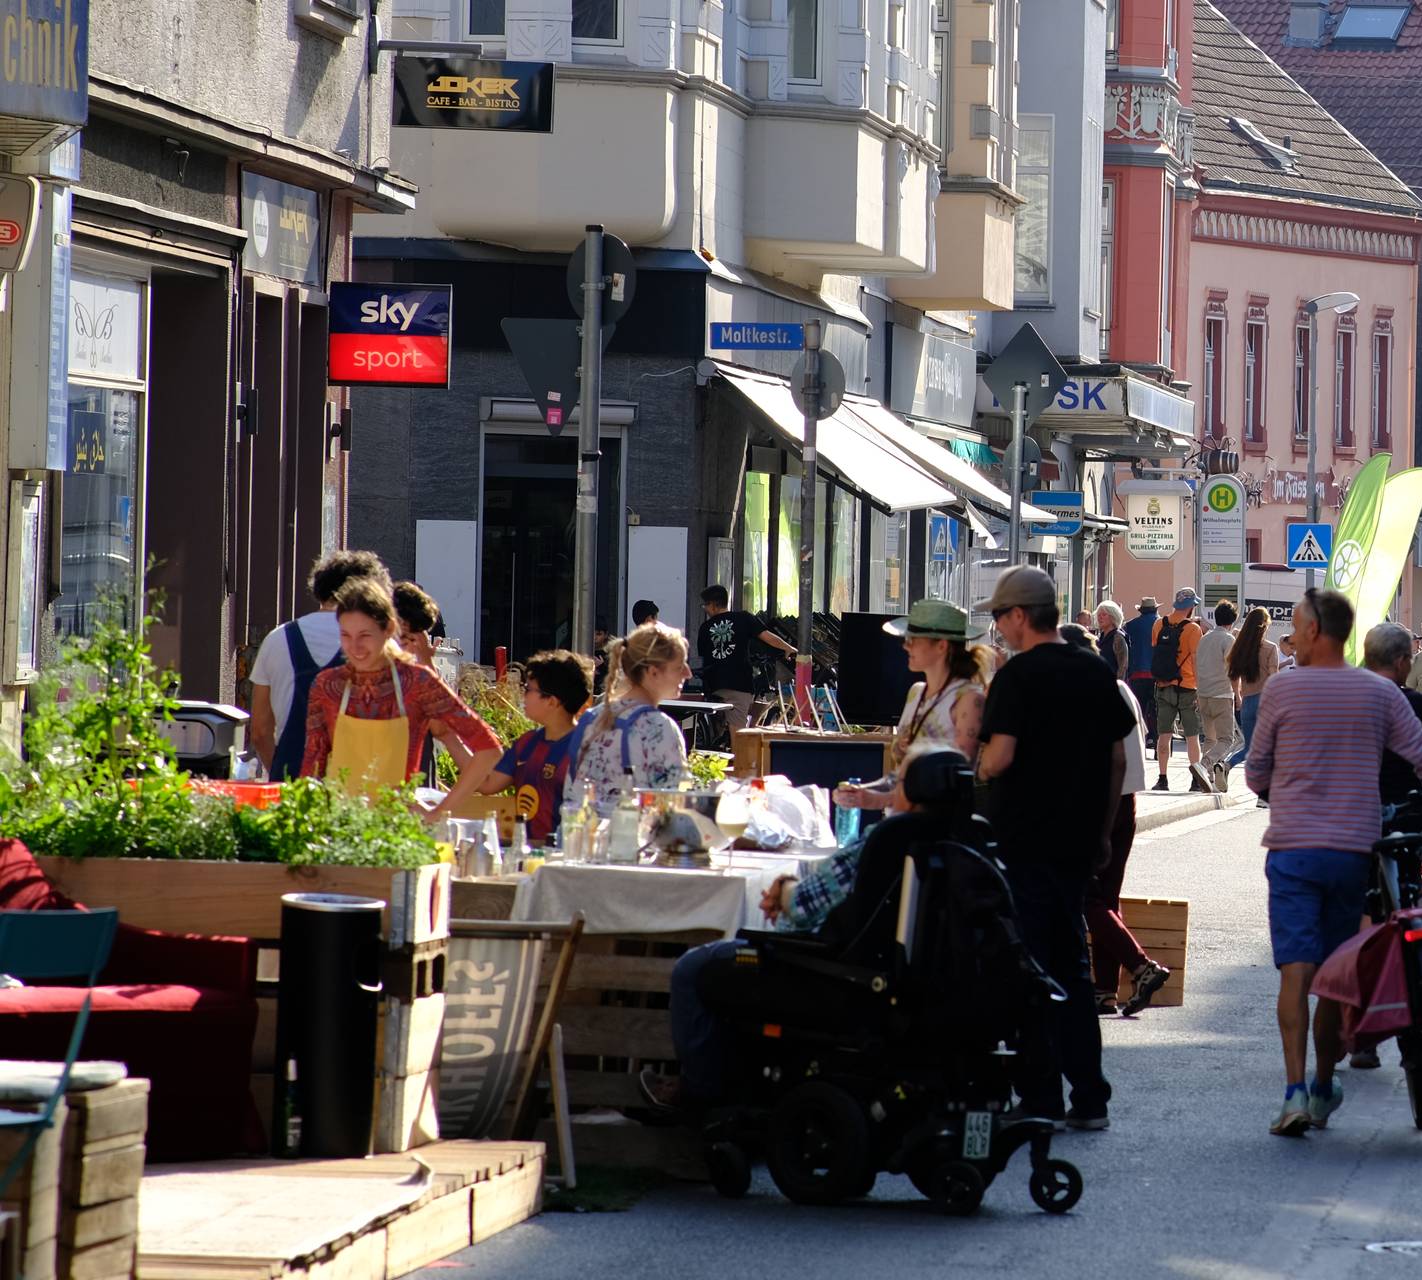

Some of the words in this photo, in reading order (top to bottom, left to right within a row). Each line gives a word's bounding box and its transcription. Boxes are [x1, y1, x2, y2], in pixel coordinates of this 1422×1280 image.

[4, 0, 79, 92] chnik
[427, 76, 521, 99] JOKER
[427, 97, 450, 105] CAFE
[459, 98, 477, 106] BAR
[486, 99, 520, 108] BISTRO
[360, 295, 420, 331] sky
[721, 326, 792, 344] Moltkestr.
[353, 350, 423, 371] sport
[1286, 472, 1325, 504] Fässen
[1134, 517, 1173, 525] VELTINS
